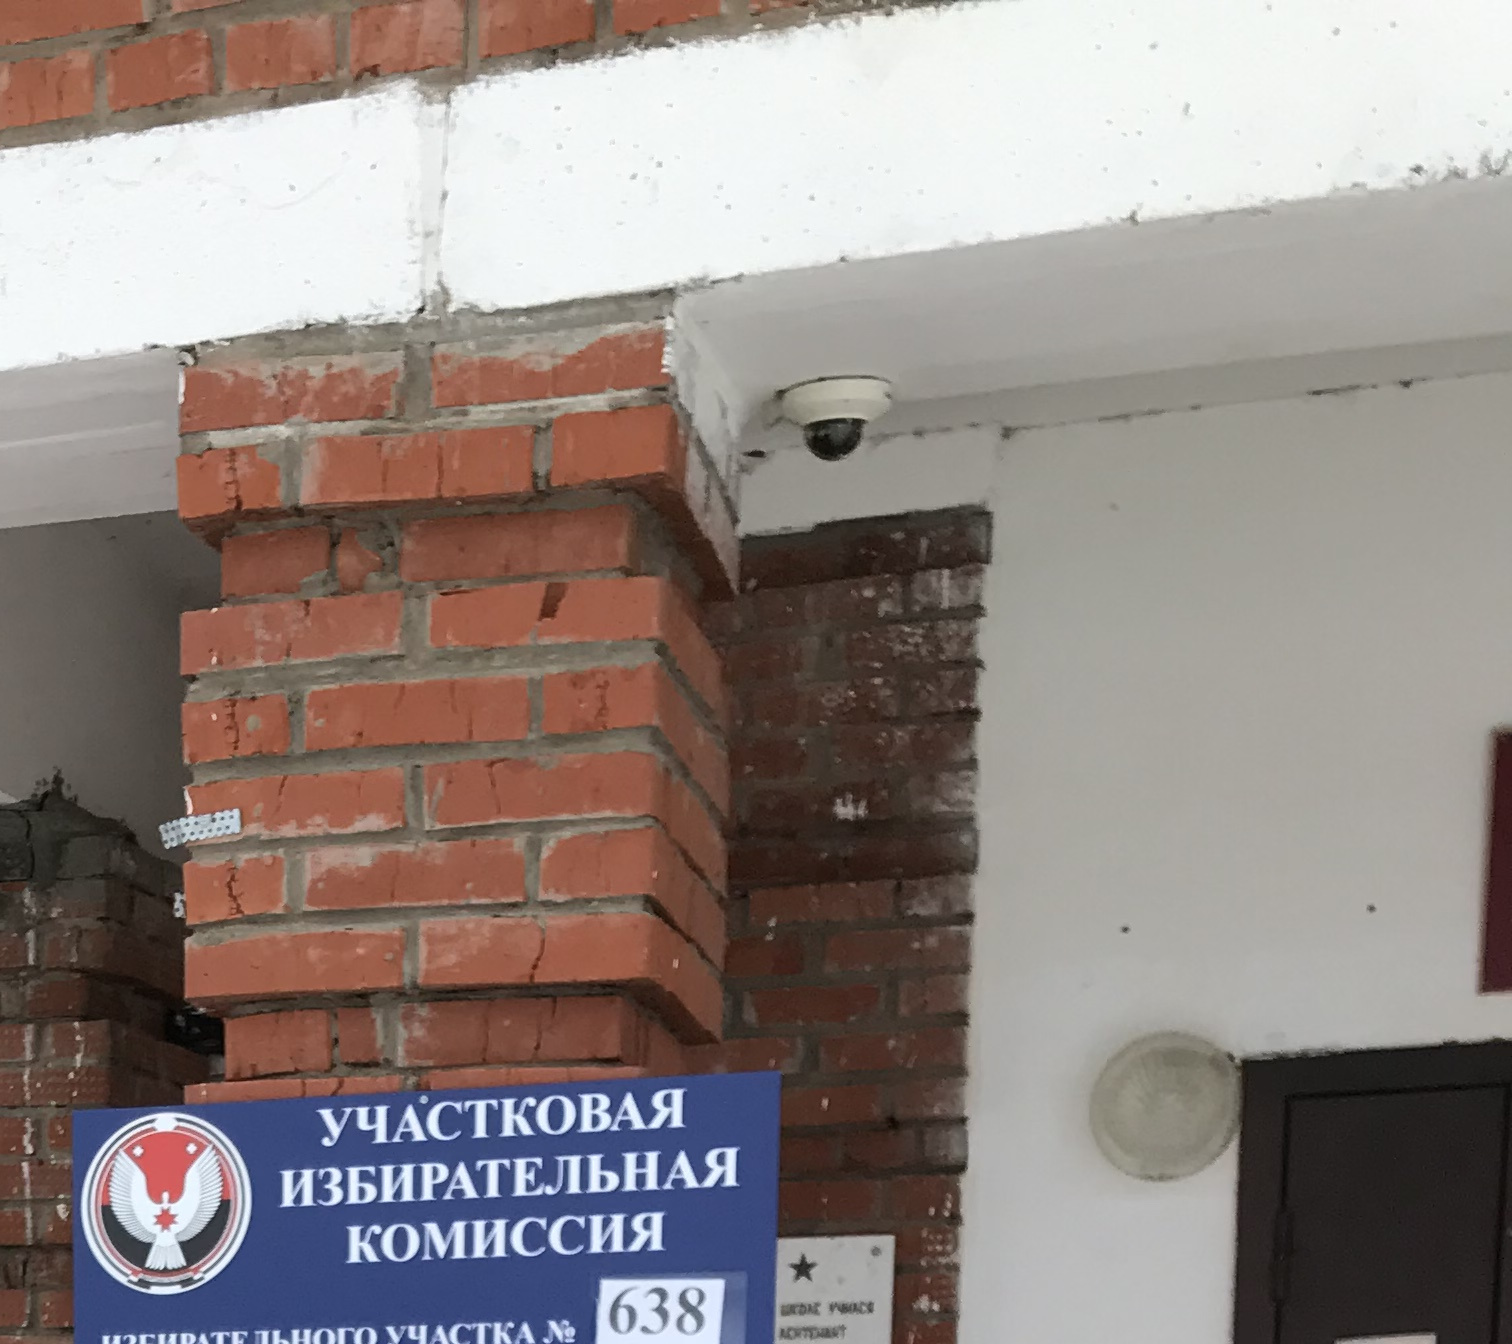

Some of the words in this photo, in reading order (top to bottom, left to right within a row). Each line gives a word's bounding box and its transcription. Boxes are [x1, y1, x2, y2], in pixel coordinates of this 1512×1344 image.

[317, 1088, 686, 1147] УЧАСТКОВАЯ
[279, 1147, 740, 1208] ИЗБИРАТЕЛЬНАЯ
[345, 1211, 666, 1264] КОМИССИЯ
[543, 1319, 577, 1344] №
[608, 1287, 706, 1334] 638
